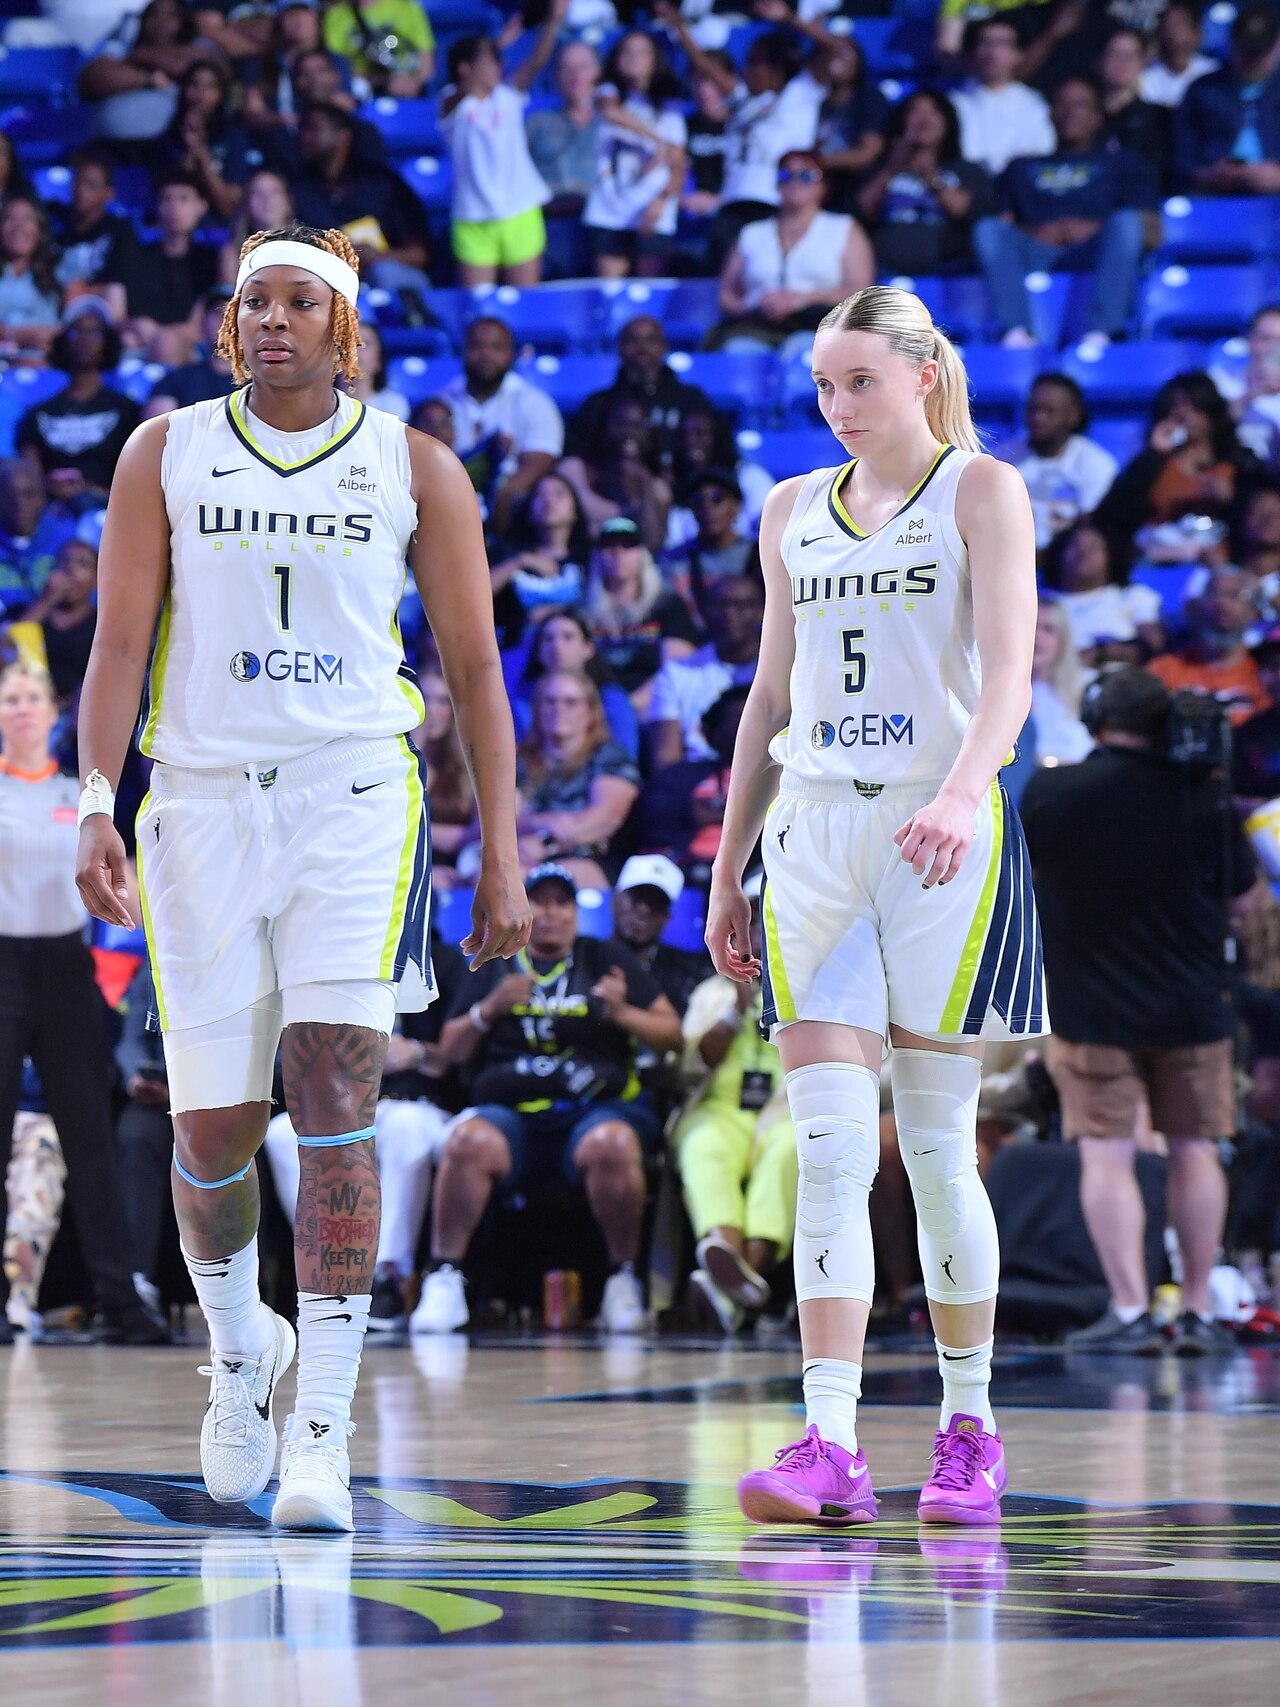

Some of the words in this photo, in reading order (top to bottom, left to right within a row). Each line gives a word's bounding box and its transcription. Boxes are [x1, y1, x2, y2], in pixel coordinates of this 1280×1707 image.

[337, 478, 377, 493] Albert
[197, 501, 375, 545] WINGS
[895, 532, 933, 545] Albert
[214, 539, 353, 557] DALLAS
[272, 564, 293, 634] 1
[265, 649, 343, 685] GEM
[839, 626, 867, 696] 5
[838, 714, 914, 748] GEM
[329, 1182, 363, 1217] MY
[320, 1243, 368, 1273] KEEPER
